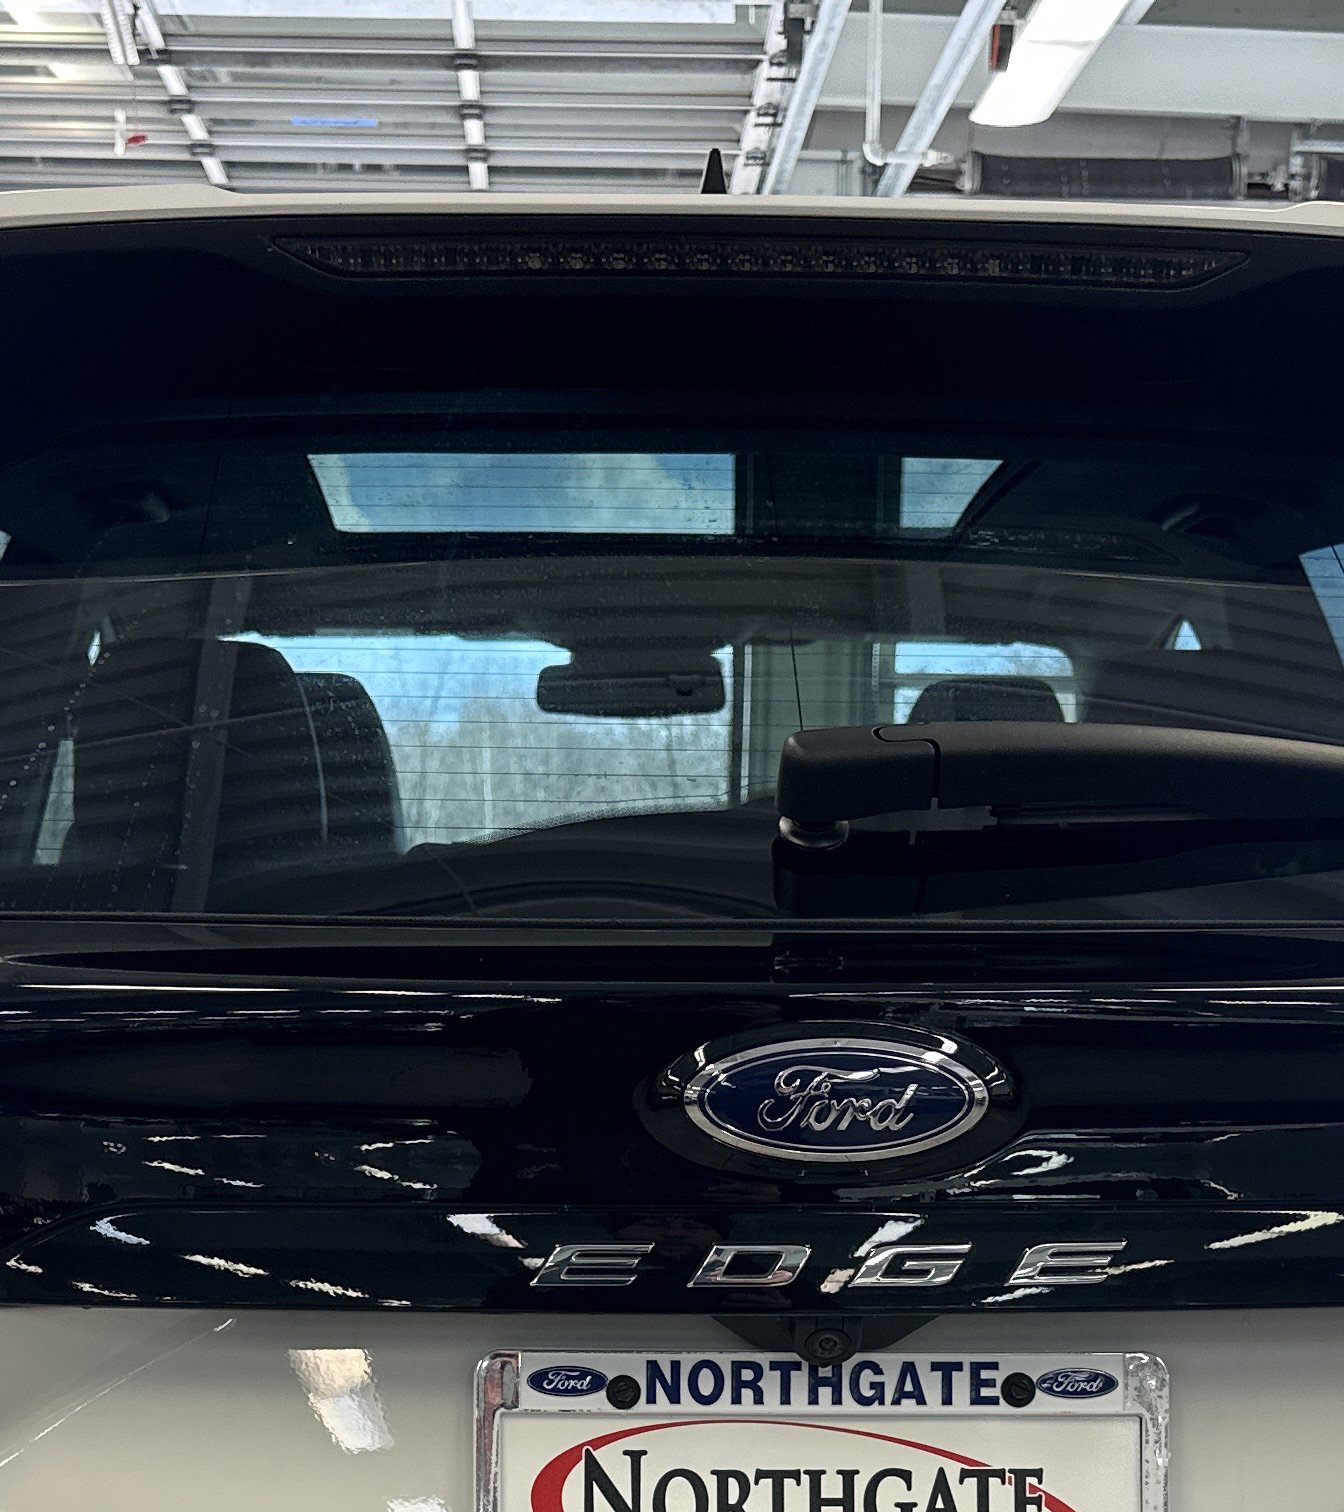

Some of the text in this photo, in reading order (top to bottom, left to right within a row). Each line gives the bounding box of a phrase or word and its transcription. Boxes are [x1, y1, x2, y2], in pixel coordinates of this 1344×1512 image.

[758, 1065, 916, 1132] Ford
[530, 1240, 1127, 1288] EDGE
[542, 1370, 592, 1390] Ford
[645, 1358, 1001, 1407] NORTHGATE
[1051, 1371, 1103, 1392] Ford
